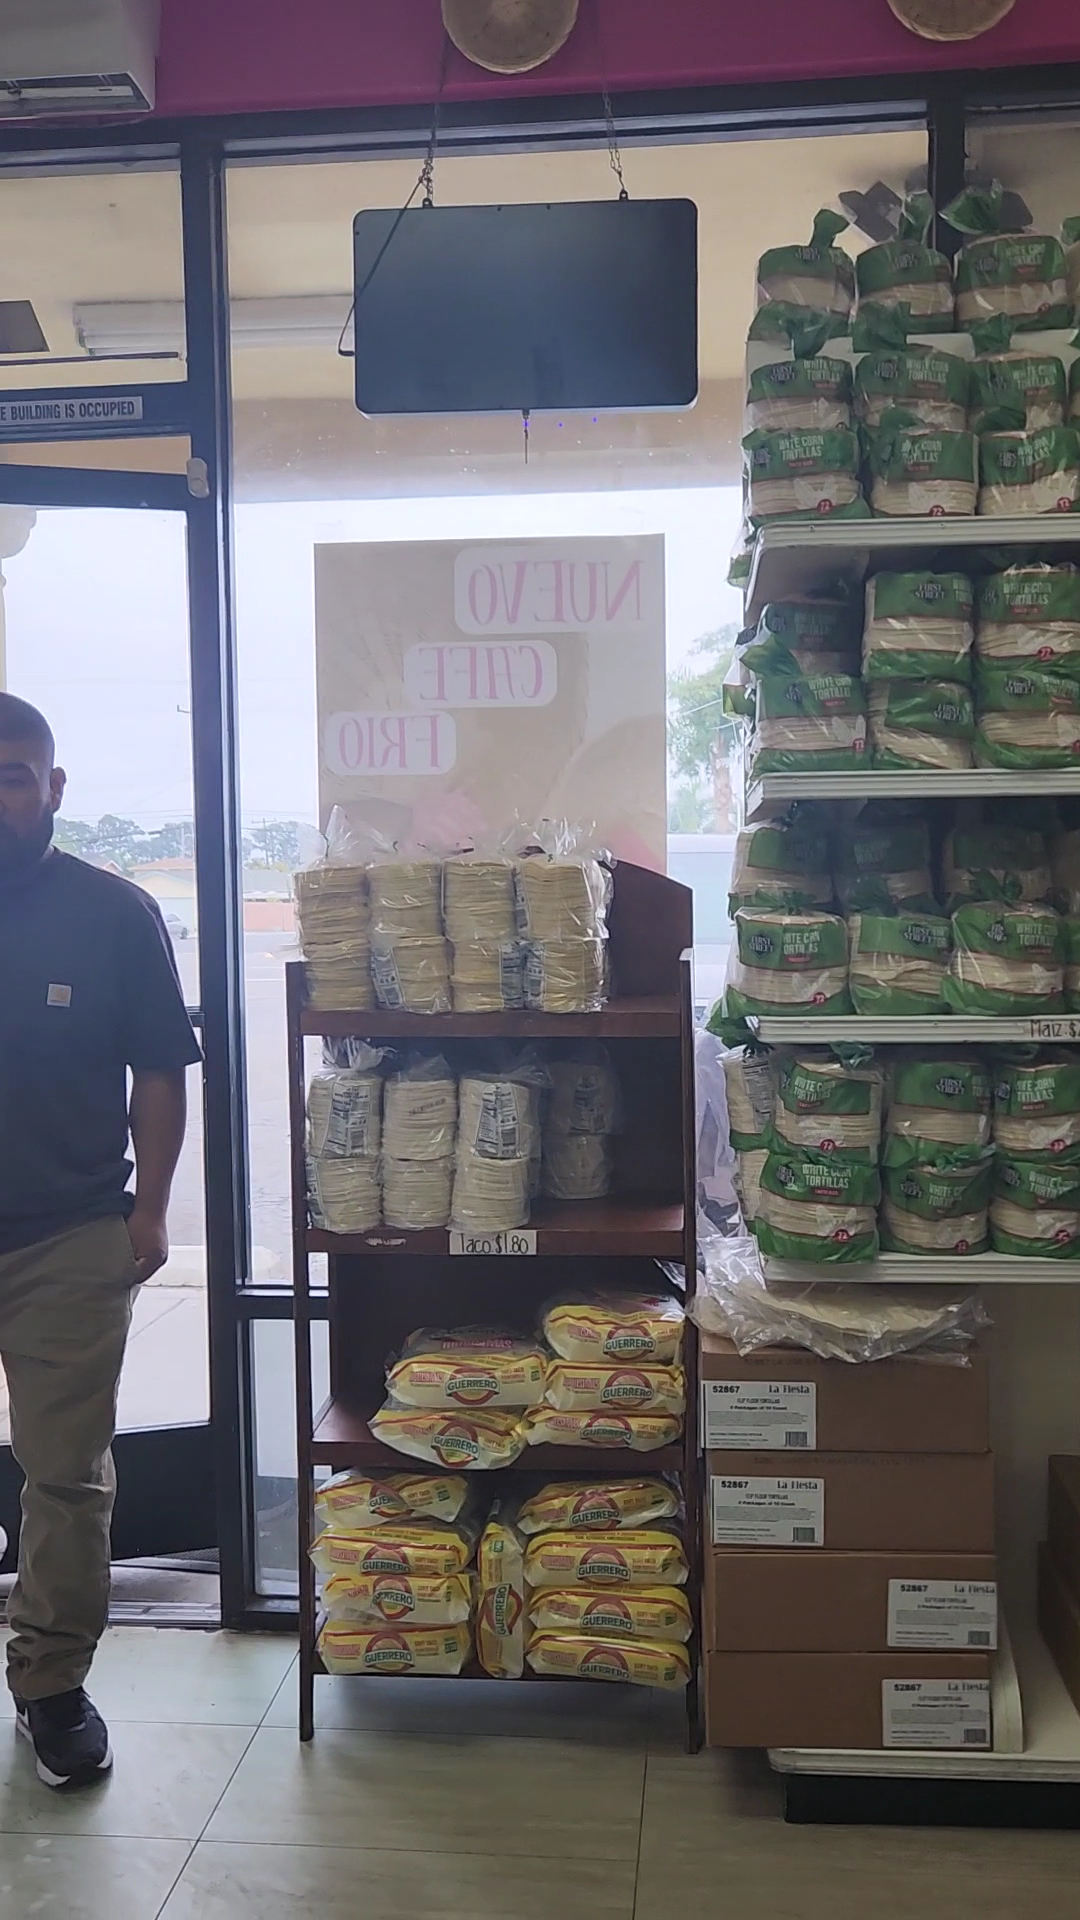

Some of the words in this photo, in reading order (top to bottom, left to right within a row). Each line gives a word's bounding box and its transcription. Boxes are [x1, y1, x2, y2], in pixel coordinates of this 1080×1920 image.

[11, 403, 61, 421] BUILDING
[65, 403, 75, 419] IS
[79, 400, 135, 418] OCCUPIED
[801, 435, 824, 447] CORN
[819, 501, 830, 512] 72
[932, 507, 943, 516] 72
[918, 583, 942, 592] FIRST
[914, 591, 945, 600] STREET
[1005, 593, 1048, 606] TORTILLAS
[808, 676, 835, 690] WHITE
[937, 703, 961, 713] FIRST
[908, 926, 931, 935] FIRST
[1015, 922, 1042, 935] WHITE
[751, 936, 773, 945] FIRST
[749, 942, 775, 953] STREET
[794, 1076, 816, 1091] WHITE
[939, 1078, 963, 1087] FIRST
[936, 1084, 965, 1095] STREET
[802, 1164, 829, 1177] WHITE
[805, 1175, 849, 1189] TORTILLAS
[929, 1182, 952, 1197] WHITE
[837, 1230, 849, 1241] 72
[605, 1338, 655, 1350] GUERRERO
[447, 1379, 498, 1392] GUERRERO
[712, 1385, 740, 1394] 52867
[768, 1384, 780, 1394] La
[782, 1384, 811, 1394] Fiesta
[602, 1387, 653, 1399] GUERRERO
[433, 1436, 479, 1455] GUERRERO
[720, 1480, 749, 1489] 52867
[776, 1480, 788, 1489] La
[790, 1480, 818, 1490] Fiesta
[571, 1511, 620, 1525] GUERRERO
[362, 1561, 410, 1573] GUERRERO
[578, 1564, 629, 1576] GUERRERO
[900, 1584, 928, 1593] 52867
[954, 1584, 965, 1593] La
[968, 1584, 995, 1594] Fiesta
[495, 1586, 507, 1635] GUERRERO
[582, 1616, 633, 1630] GUERRERO
[364, 1652, 413, 1664] GUERRERO
[579, 1664, 630, 1680] GUERRERO
[893, 1683, 922, 1692] 52867
[947, 1682, 959, 1691] La
